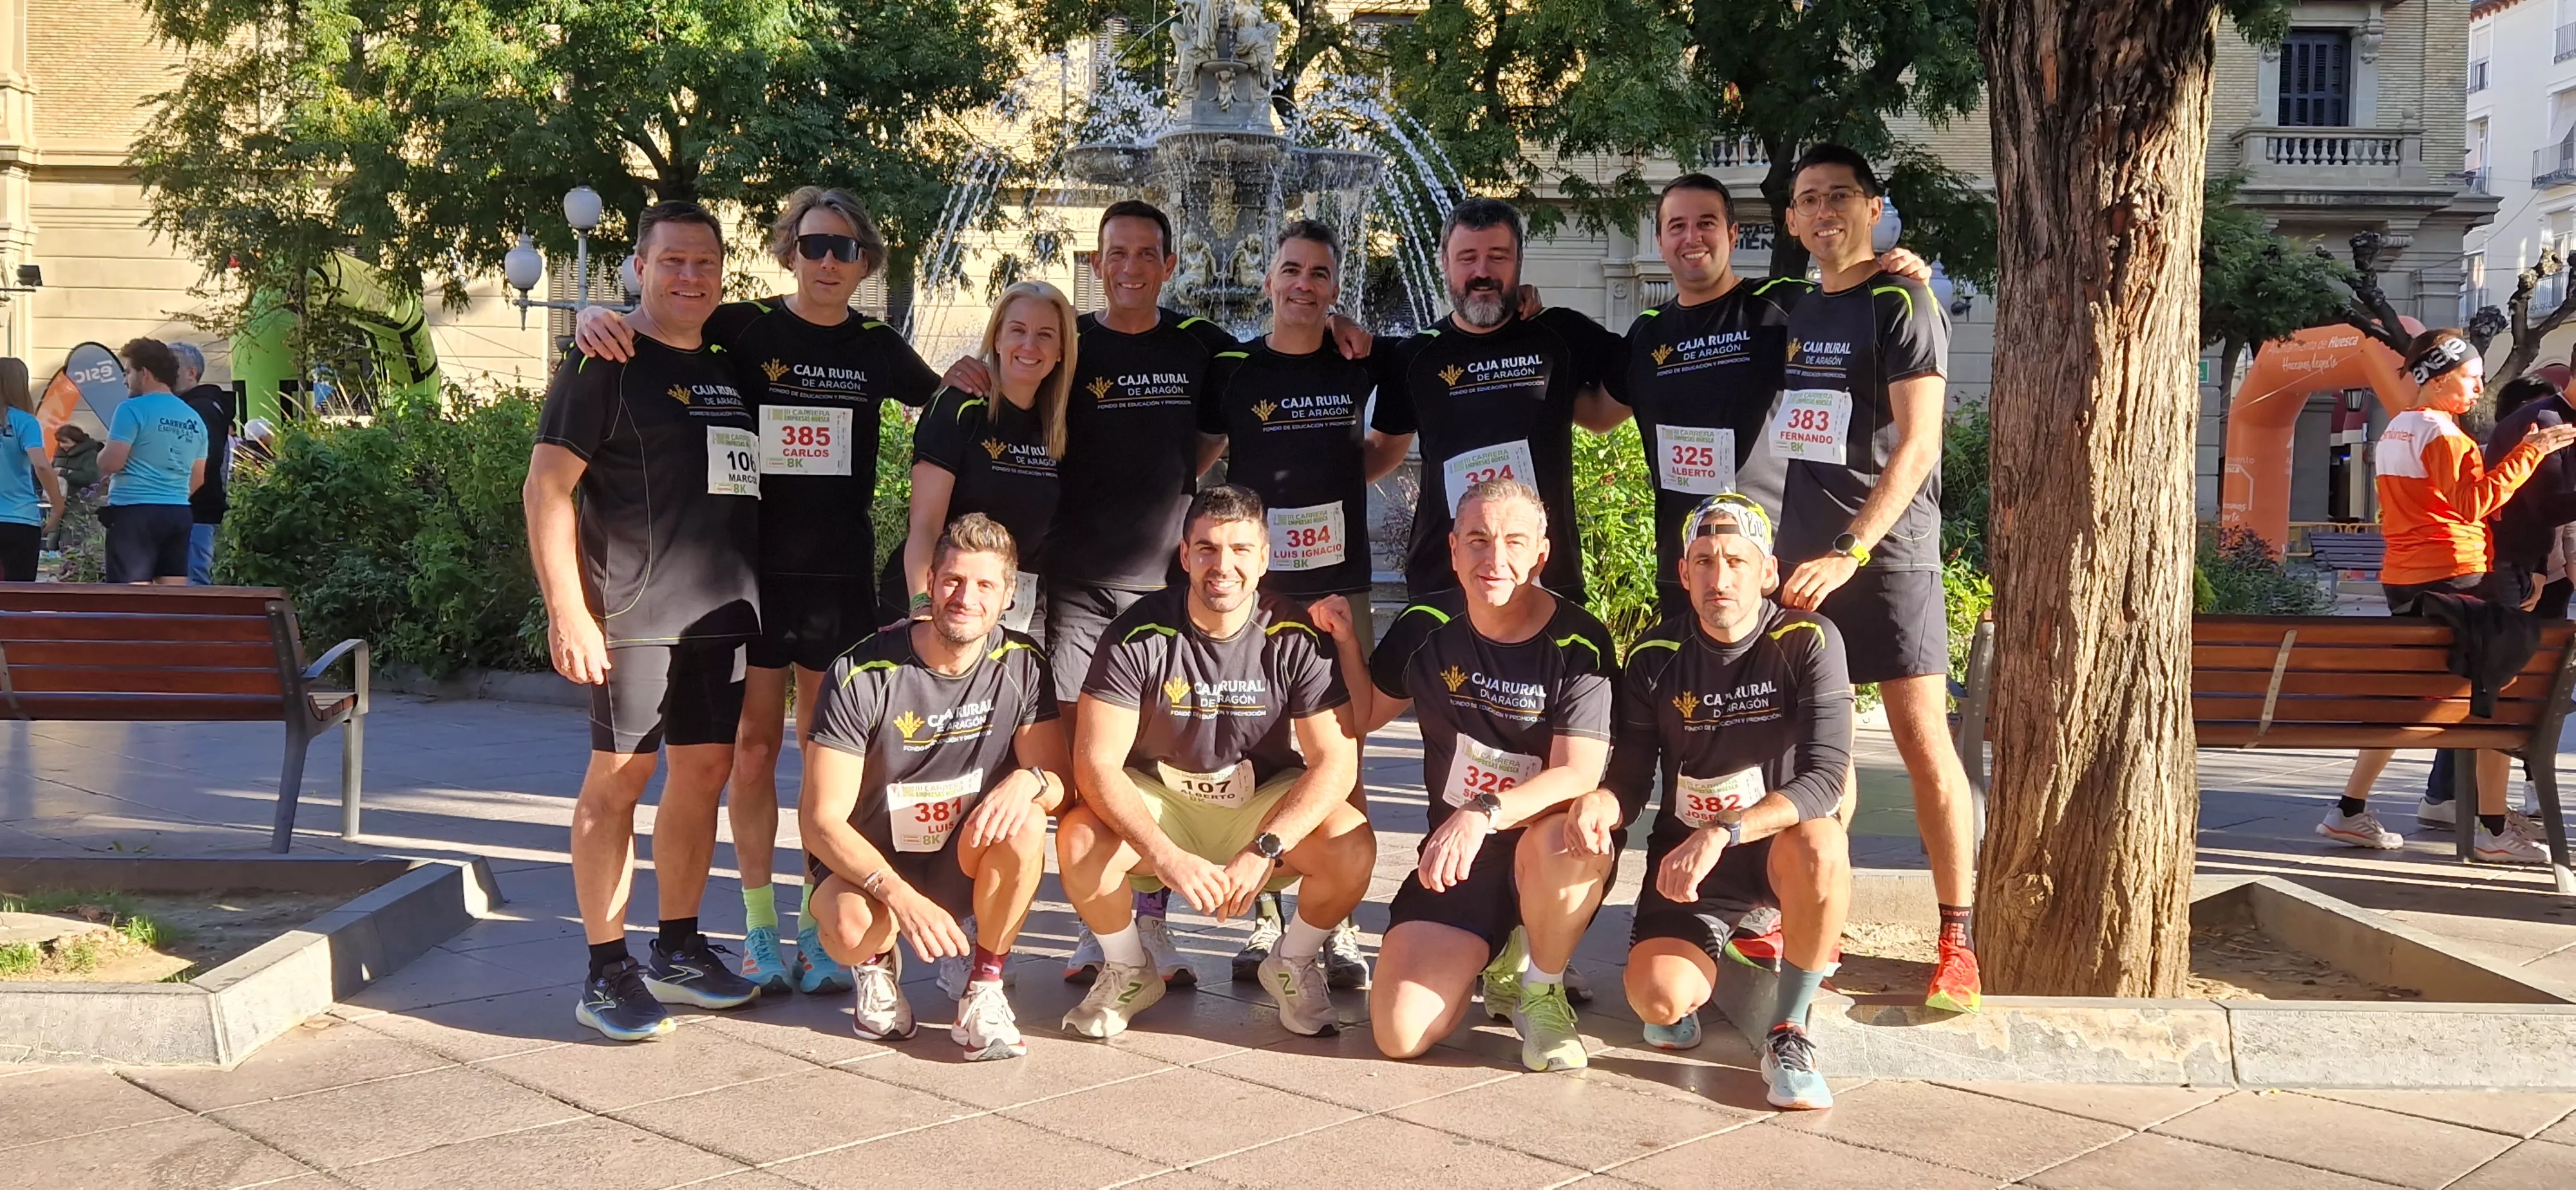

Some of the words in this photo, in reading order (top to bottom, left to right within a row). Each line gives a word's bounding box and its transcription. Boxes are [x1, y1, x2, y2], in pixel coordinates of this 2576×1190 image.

[1677, 337, 1705, 352] CAJA
[1709, 330, 1750, 346] RURAL
[1803, 341, 1823, 354] CAJA
[1824, 343, 1851, 354] RURAL
[2329, 335, 2359, 348] Huesca
[1683, 352, 1696, 361] DE
[1698, 344, 1741, 358] ARAGÓN
[1468, 360, 1499, 373] CAJA
[1501, 354, 1543, 368] RURAL
[1806, 355, 1815, 364] DE
[1815, 355, 1842, 365] ARAGÓN
[793, 364, 825, 377] CAJA
[829, 368, 867, 382] RURAL
[1118, 374, 1150, 386] CAJA
[1153, 373, 1189, 384] RURAL
[1477, 373, 1490, 381] DE
[1493, 367, 1535, 379] ARAGÓN
[692, 385, 717, 395] CAJA
[819, 380, 860, 390] ARAGÓN
[1144, 385, 1184, 395] ARAGÓN
[1282, 397, 1314, 408] CAJA
[1316, 394, 1353, 406] RURAL
[1292, 410, 1305, 419] DE
[1309, 406, 1349, 417] ARAGÓN
[1788, 408, 1829, 431] 383
[782, 426, 830, 446] 385
[1780, 431, 1833, 444] FERNANDO
[783, 448, 829, 457] CARLOS
[1790, 442, 1804, 452] 8K
[1016, 456, 1025, 464] DE
[1472, 449, 1508, 461] CARRERA
[1672, 446, 1713, 466] 325
[727, 451, 756, 473] 106
[787, 458, 803, 468] 8K
[1672, 467, 1716, 478] ALBERTO
[1678, 477, 1689, 486] 8K
[734, 484, 746, 493] 8K
[1296, 510, 1327, 520] CARRERA
[1287, 525, 1330, 547] 384
[1302, 543, 1341, 557] IGNACIO
[1293, 559, 1309, 568] 8K
[1221, 680, 1265, 692] RURAL
[1502, 681, 1547, 697] RURAL
[1734, 681, 1777, 698] RURAL
[1200, 698, 1216, 707] DE
[1217, 694, 1256, 704] RAGÓN
[1491, 694, 1536, 708] ARAGÓN
[1727, 697, 1769, 712] ARAGÓN
[956, 699, 994, 717] RURAL
[947, 715, 987, 731] ARAGÓN
[1746, 713, 1782, 722] PROMOCIÓN
[1481, 752, 1520, 767] CARRERA
[1464, 766, 1515, 793] 326
[1181, 780, 1231, 793] 107
[1180, 789, 1235, 800] ALBERTO
[1687, 794, 1743, 812] 382
[914, 798, 962, 822] 381
[928, 822, 954, 834] LUIS
[923, 835, 941, 845] 8K
